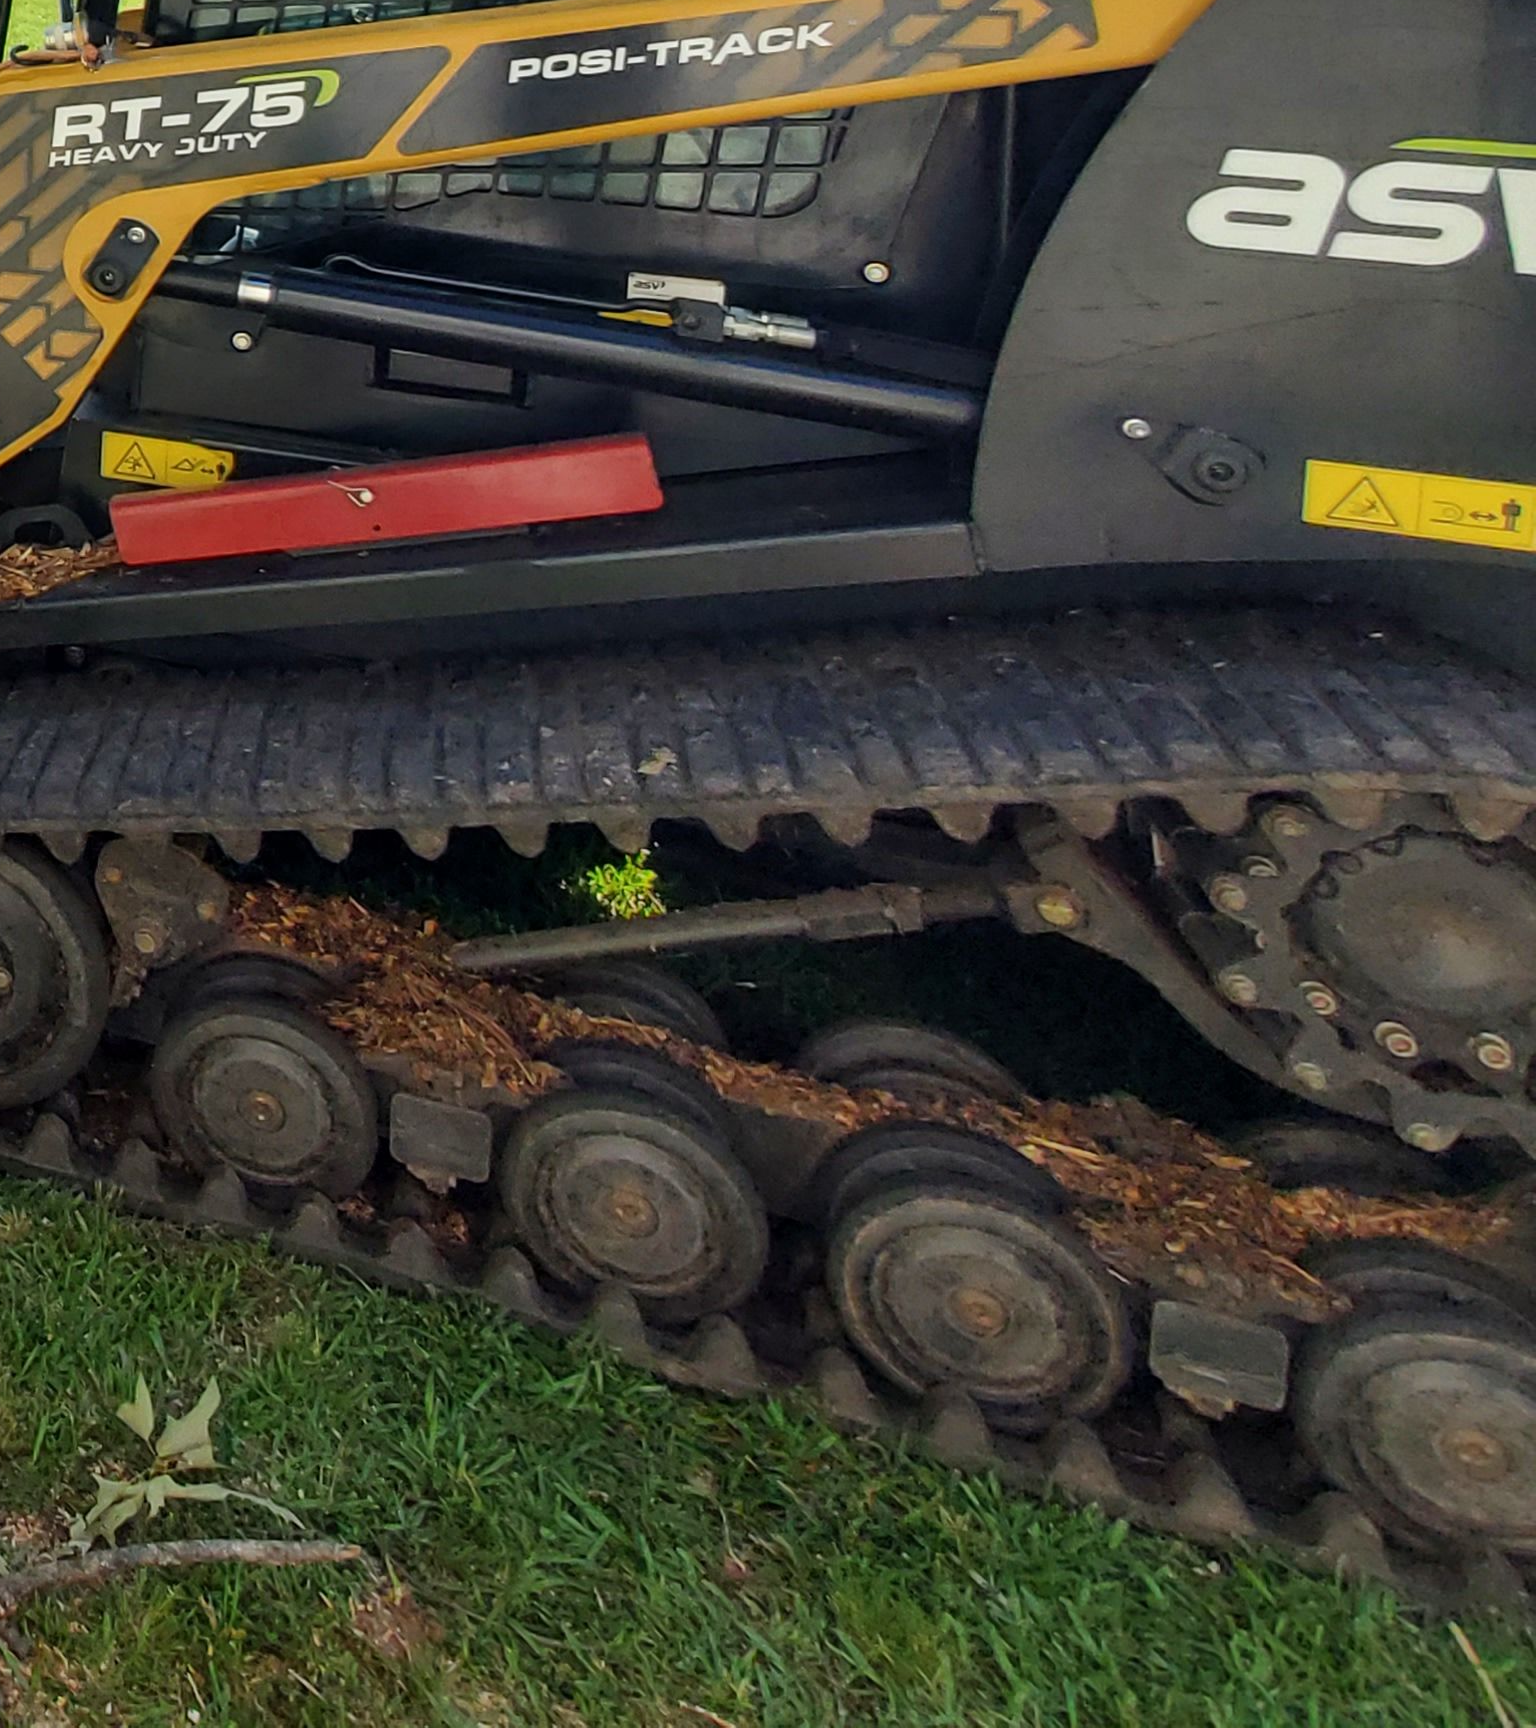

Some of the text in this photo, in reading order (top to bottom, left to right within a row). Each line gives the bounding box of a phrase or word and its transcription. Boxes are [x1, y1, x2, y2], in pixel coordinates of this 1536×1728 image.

[508, 22, 834, 85] POSI-TRACK
[51, 80, 306, 148] RT-75
[48, 142, 164, 168] HEAVY
